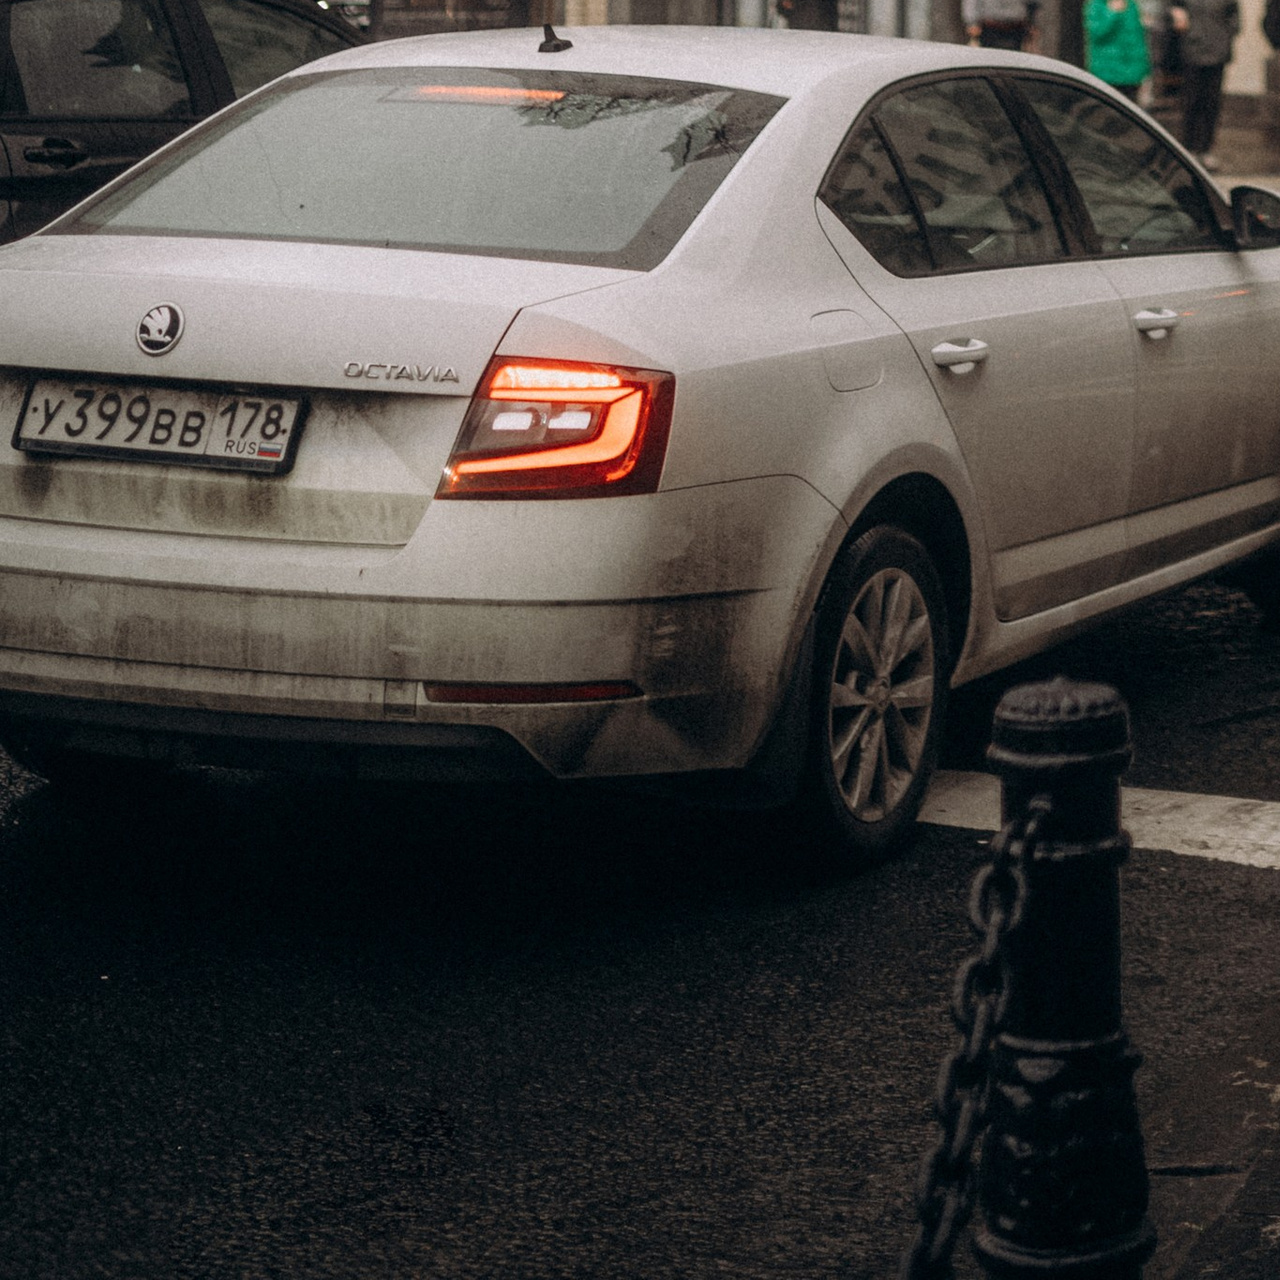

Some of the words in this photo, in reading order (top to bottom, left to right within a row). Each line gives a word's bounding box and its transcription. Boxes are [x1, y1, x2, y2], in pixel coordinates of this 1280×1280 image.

[343, 361, 460, 383] OCTAVIA
[219, 400, 284, 440] 178
[224, 439, 257, 456] RUS
